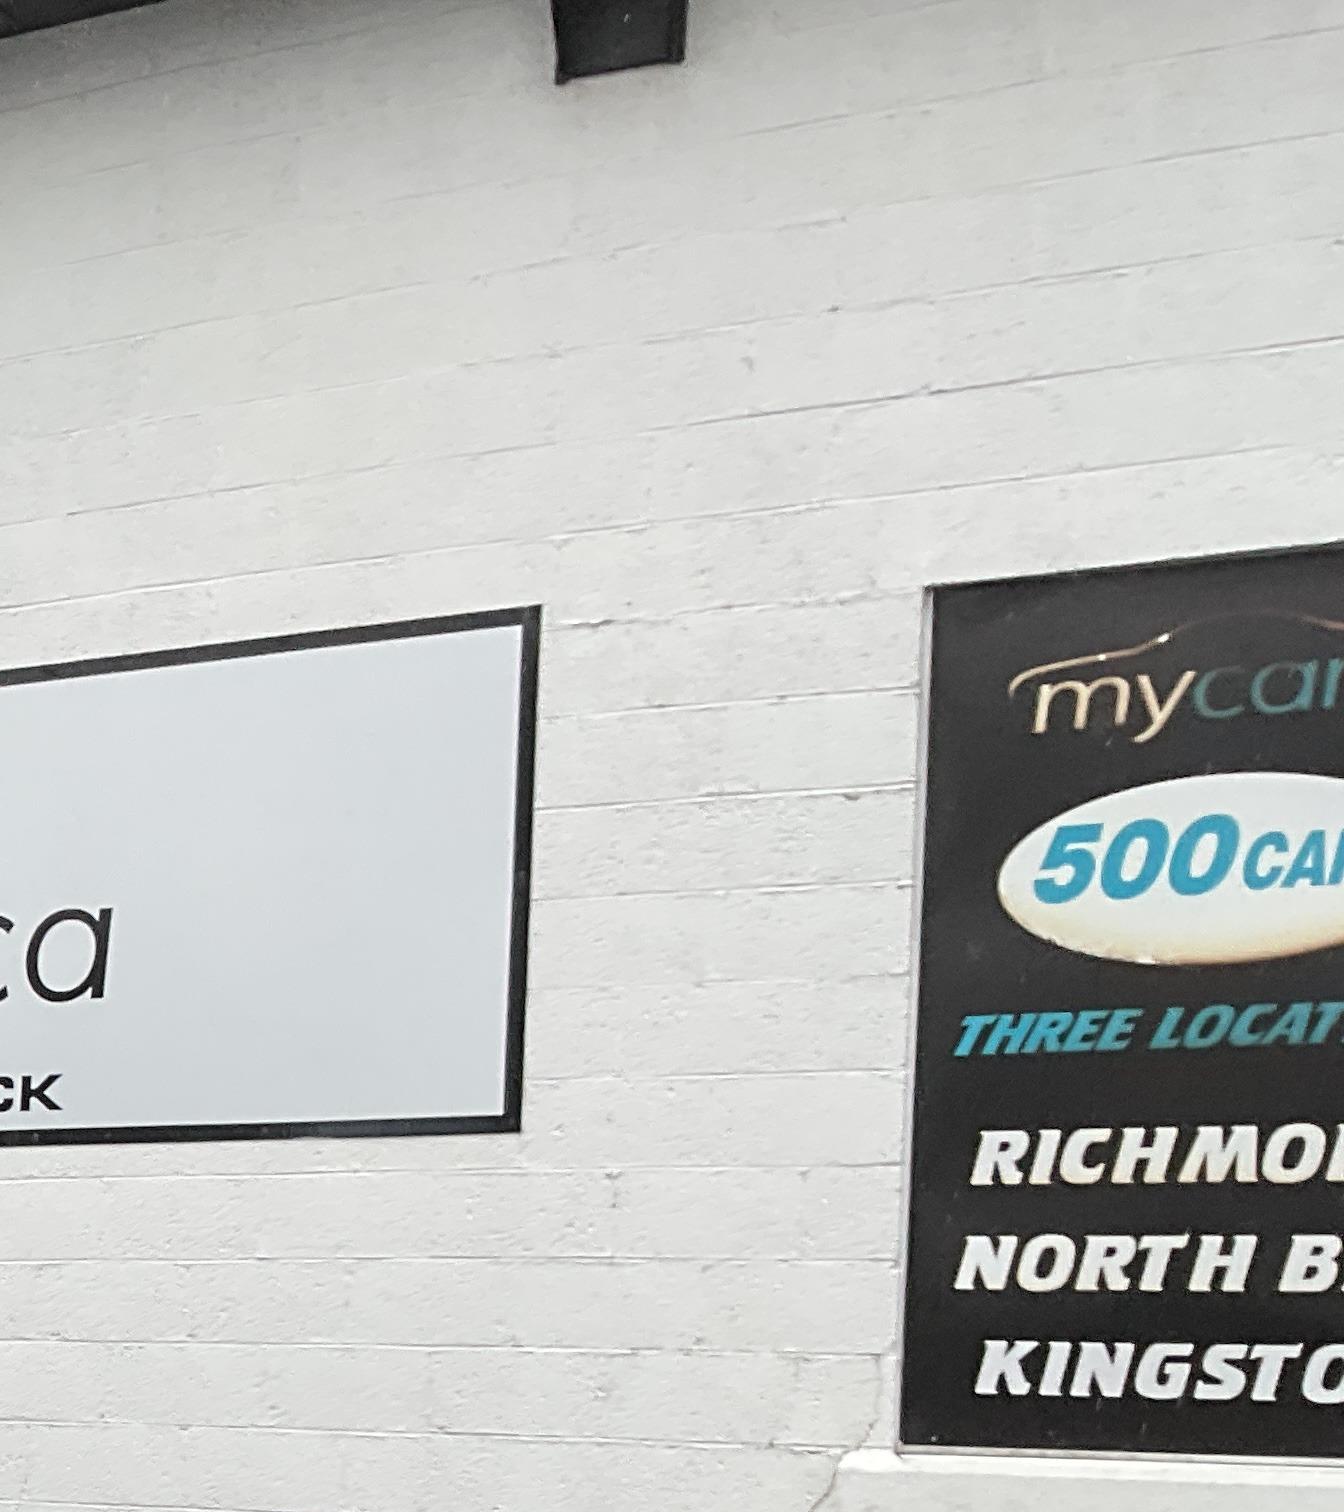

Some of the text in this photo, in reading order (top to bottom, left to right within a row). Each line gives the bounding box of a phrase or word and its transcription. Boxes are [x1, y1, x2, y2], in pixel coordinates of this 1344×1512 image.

[953, 1001, 1344, 1057] THREE LOCAT
[969, 1122, 1344, 1186] RICHMO
[953, 1233, 1258, 1293] NORTH
